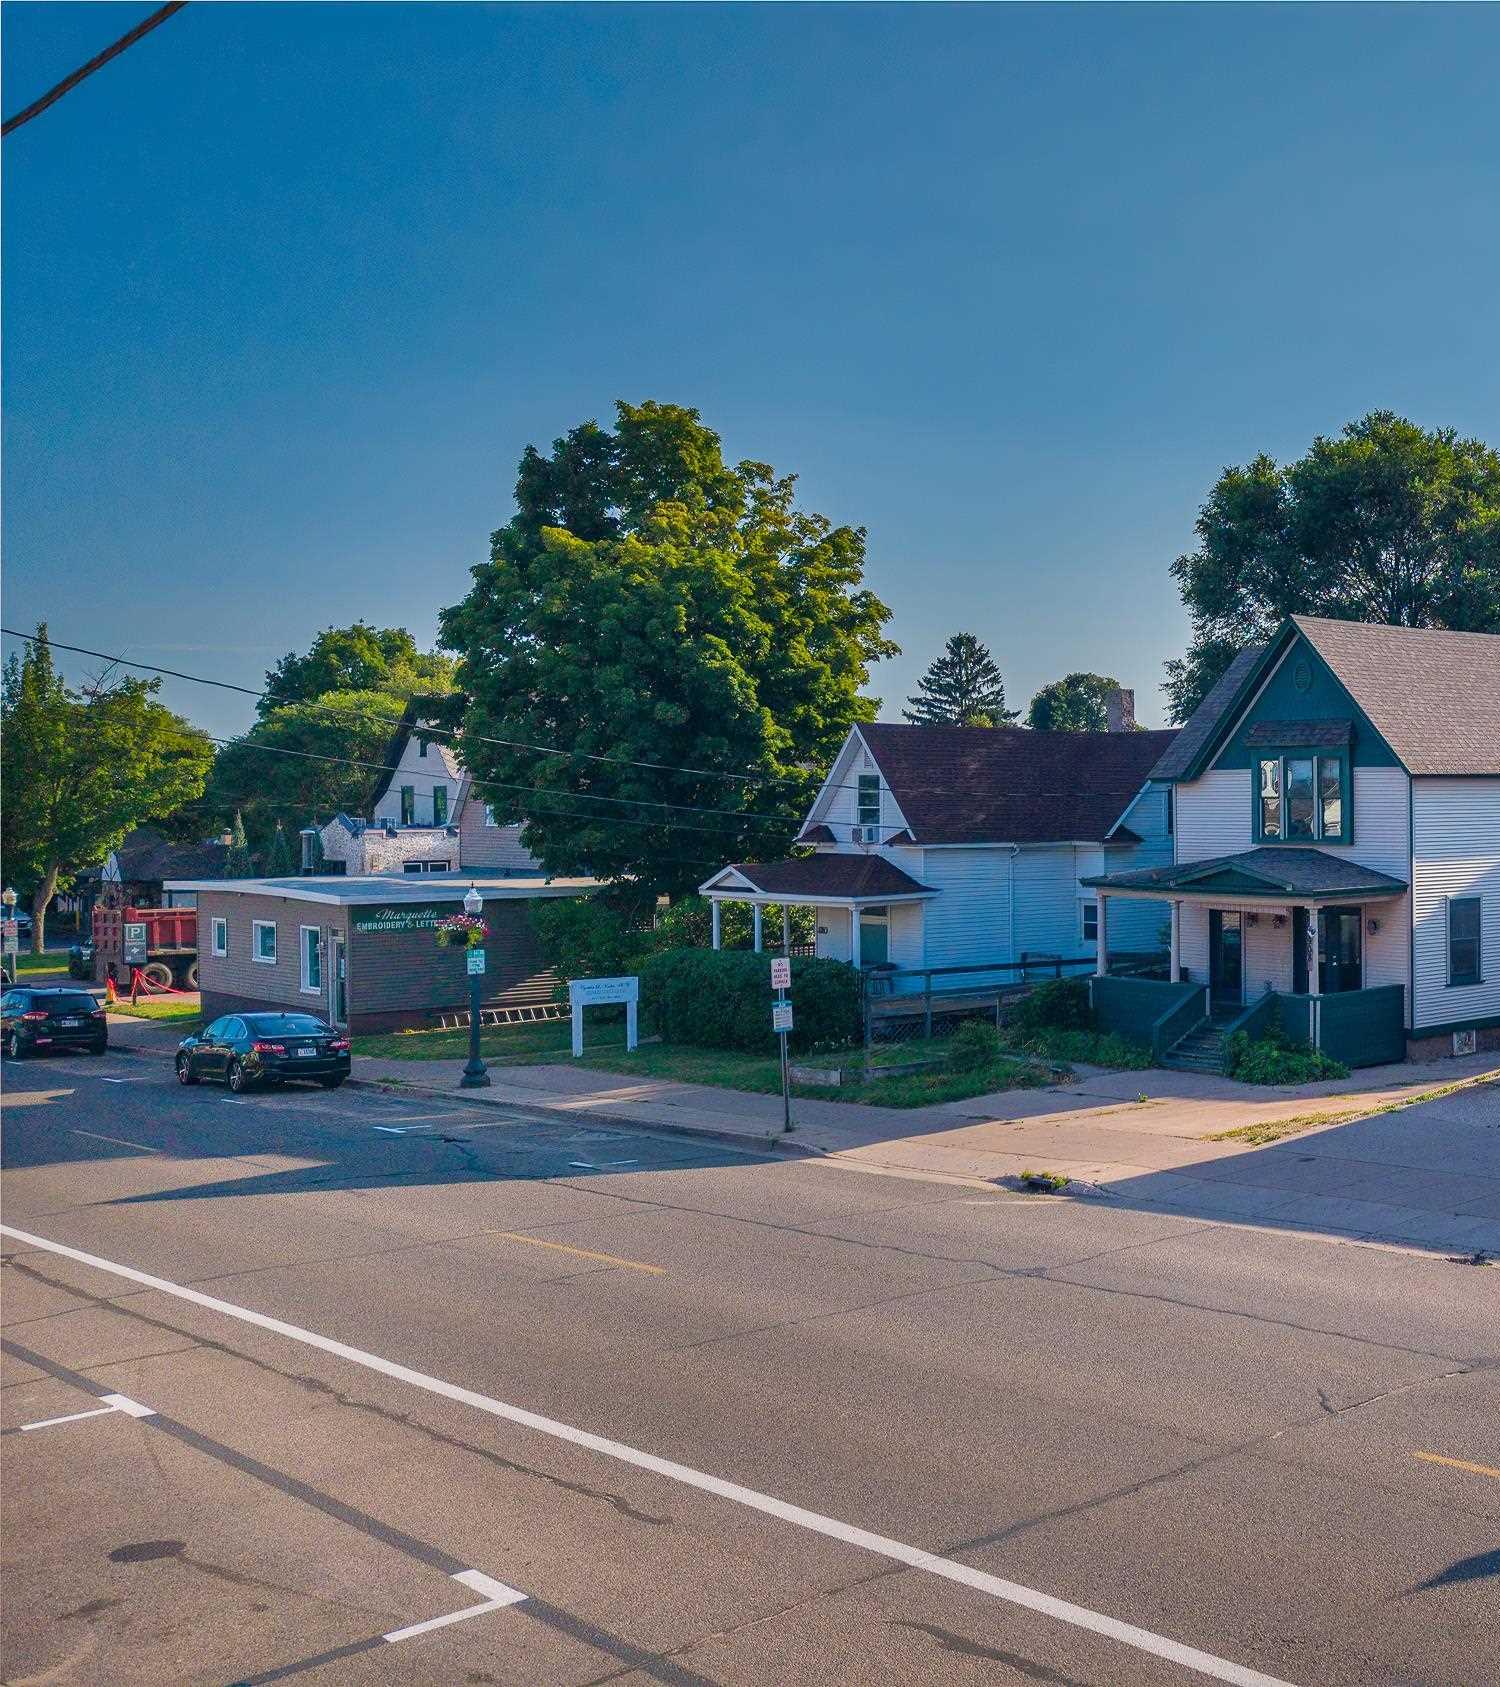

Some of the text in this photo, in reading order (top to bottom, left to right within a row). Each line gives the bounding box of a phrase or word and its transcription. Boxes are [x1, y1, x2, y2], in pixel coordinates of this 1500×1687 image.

[376, 909, 437, 921] Marquette
[357, 921, 404, 930] EMBROIDERY
[131, 928, 140, 938] P
